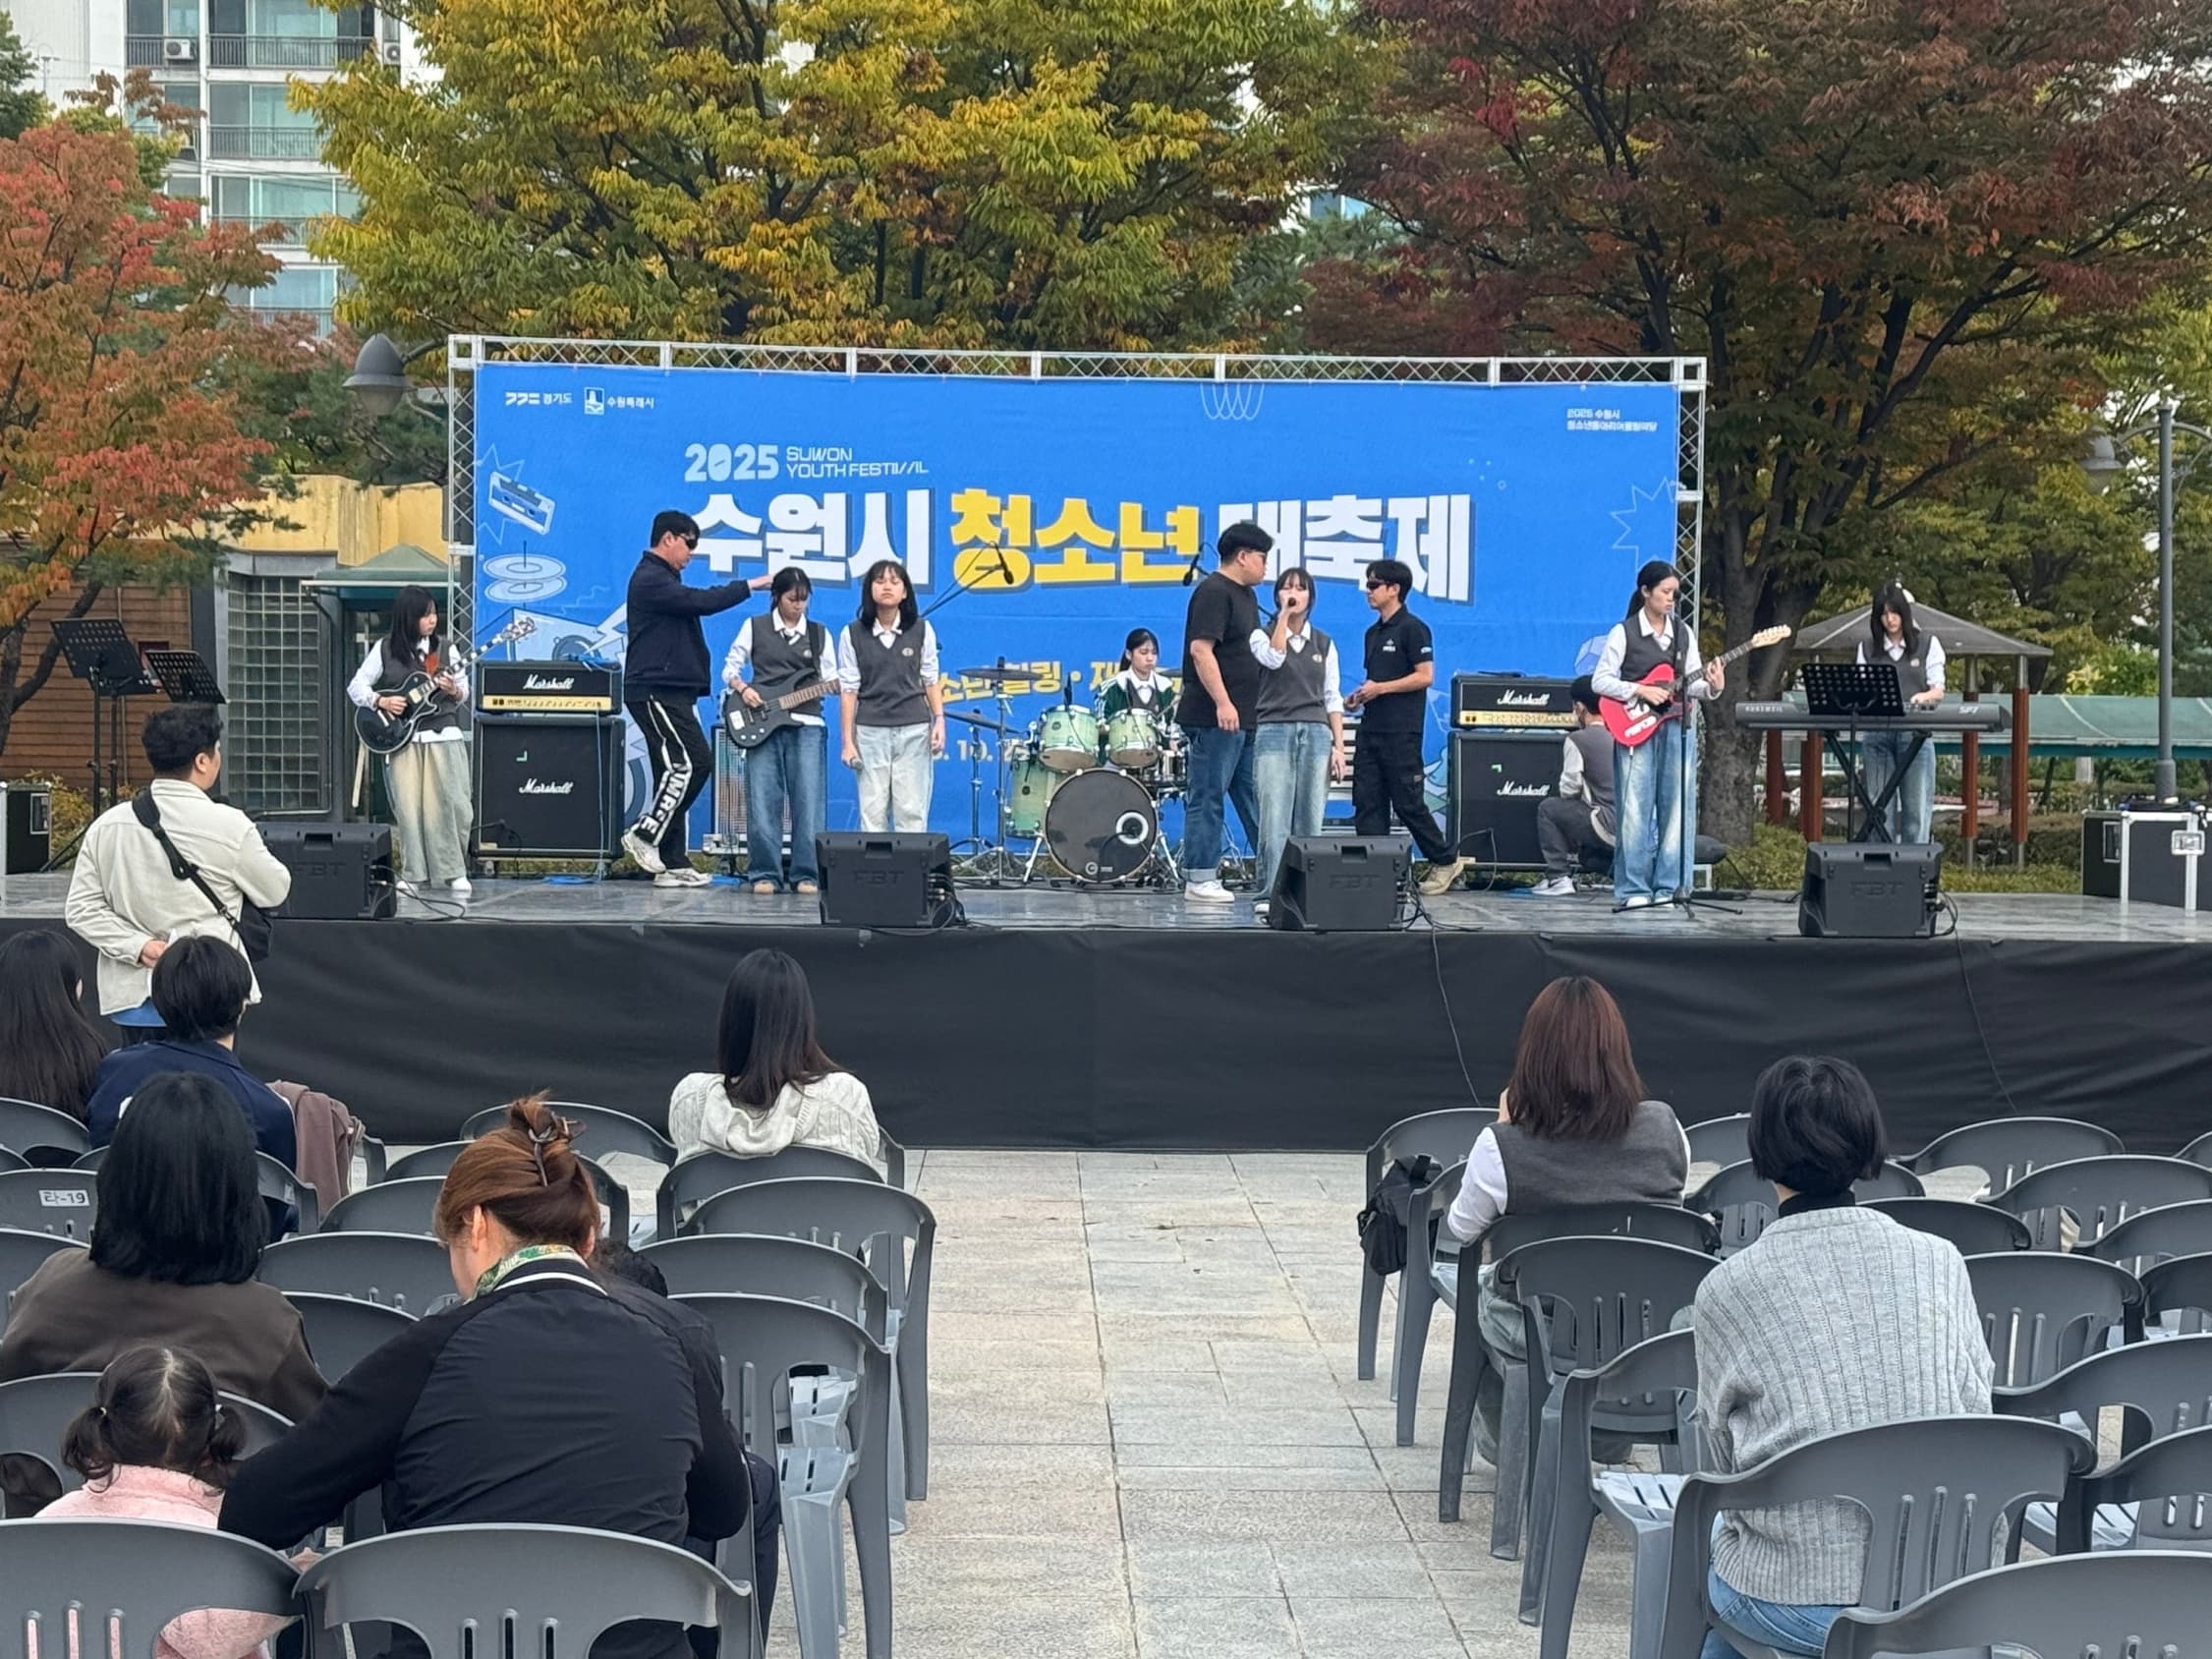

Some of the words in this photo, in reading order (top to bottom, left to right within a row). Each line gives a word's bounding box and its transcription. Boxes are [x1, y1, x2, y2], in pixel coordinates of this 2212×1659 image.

[543, 392, 572, 405] 경기도
[607, 396, 654, 409] 수원특례시
[786, 446, 852, 462] SUWON
[685, 443, 778, 482] 2025
[786, 463, 846, 478] YOUTH
[691, 489, 930, 586] 수원시
[950, 488, 1199, 588] 청소년
[1219, 494, 1470, 601] 대축제
[523, 673, 575, 690] Marshall
[1497, 689, 1551, 706] Marshall
[519, 777, 574, 794] Marshall
[1497, 780, 1551, 796] Marshall
[42, 1191, 85, 1204] 라-19
